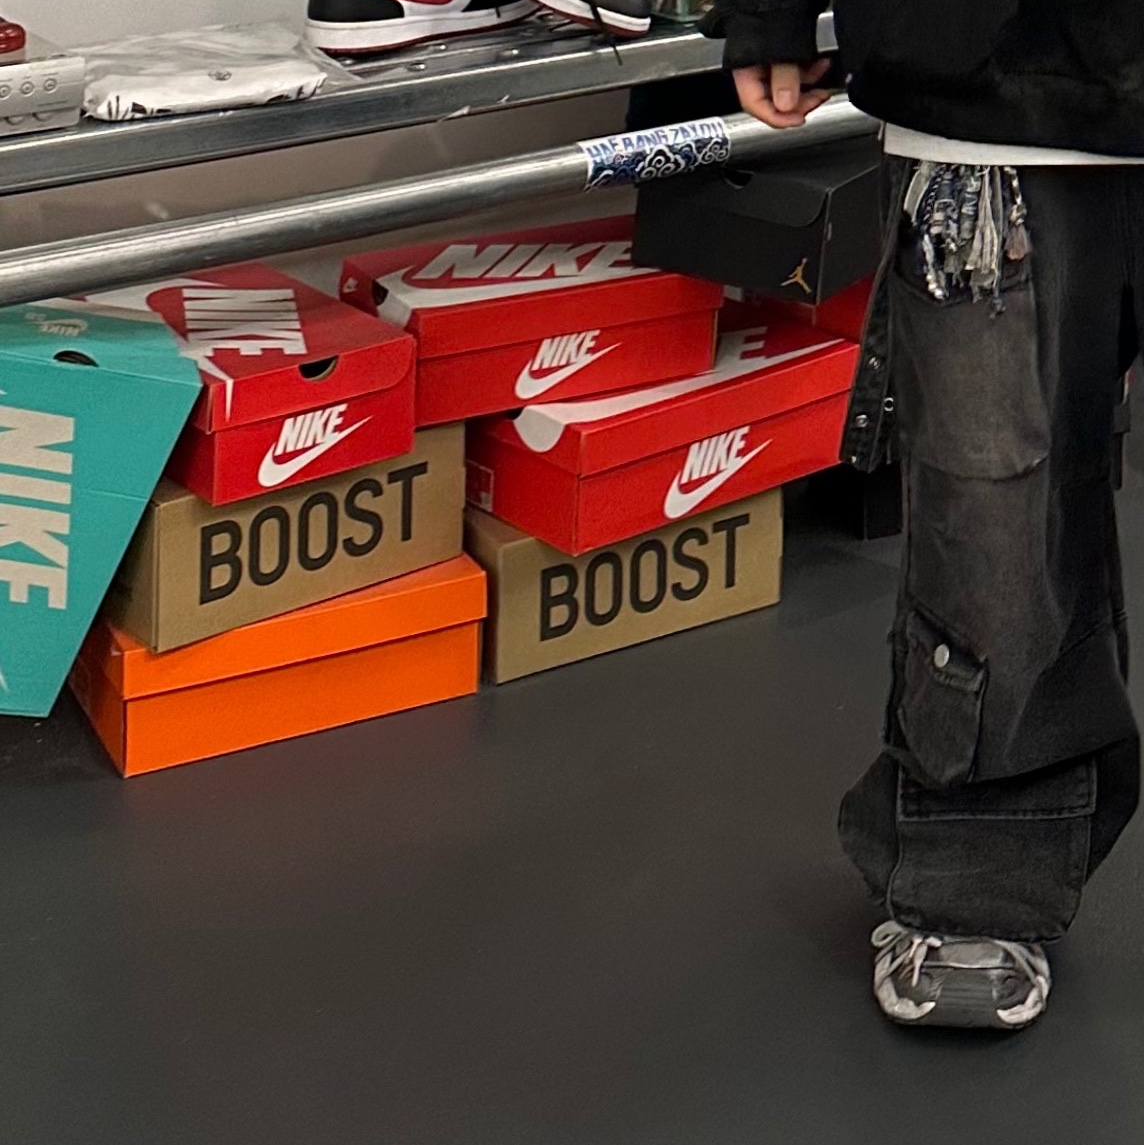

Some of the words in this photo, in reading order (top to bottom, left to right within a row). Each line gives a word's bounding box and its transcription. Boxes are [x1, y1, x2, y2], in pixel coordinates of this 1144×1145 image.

[410, 241, 633, 280] NIKE
[182, 288, 308, 357] NIKE
[530, 329, 601, 371] NIKE
[273, 403, 348, 456] NIKE
[680, 425, 750, 485] NIKE
[0, 406, 74, 610] NIKE
[199, 461, 429, 606] BOOST
[539, 513, 750, 642] BOOST
